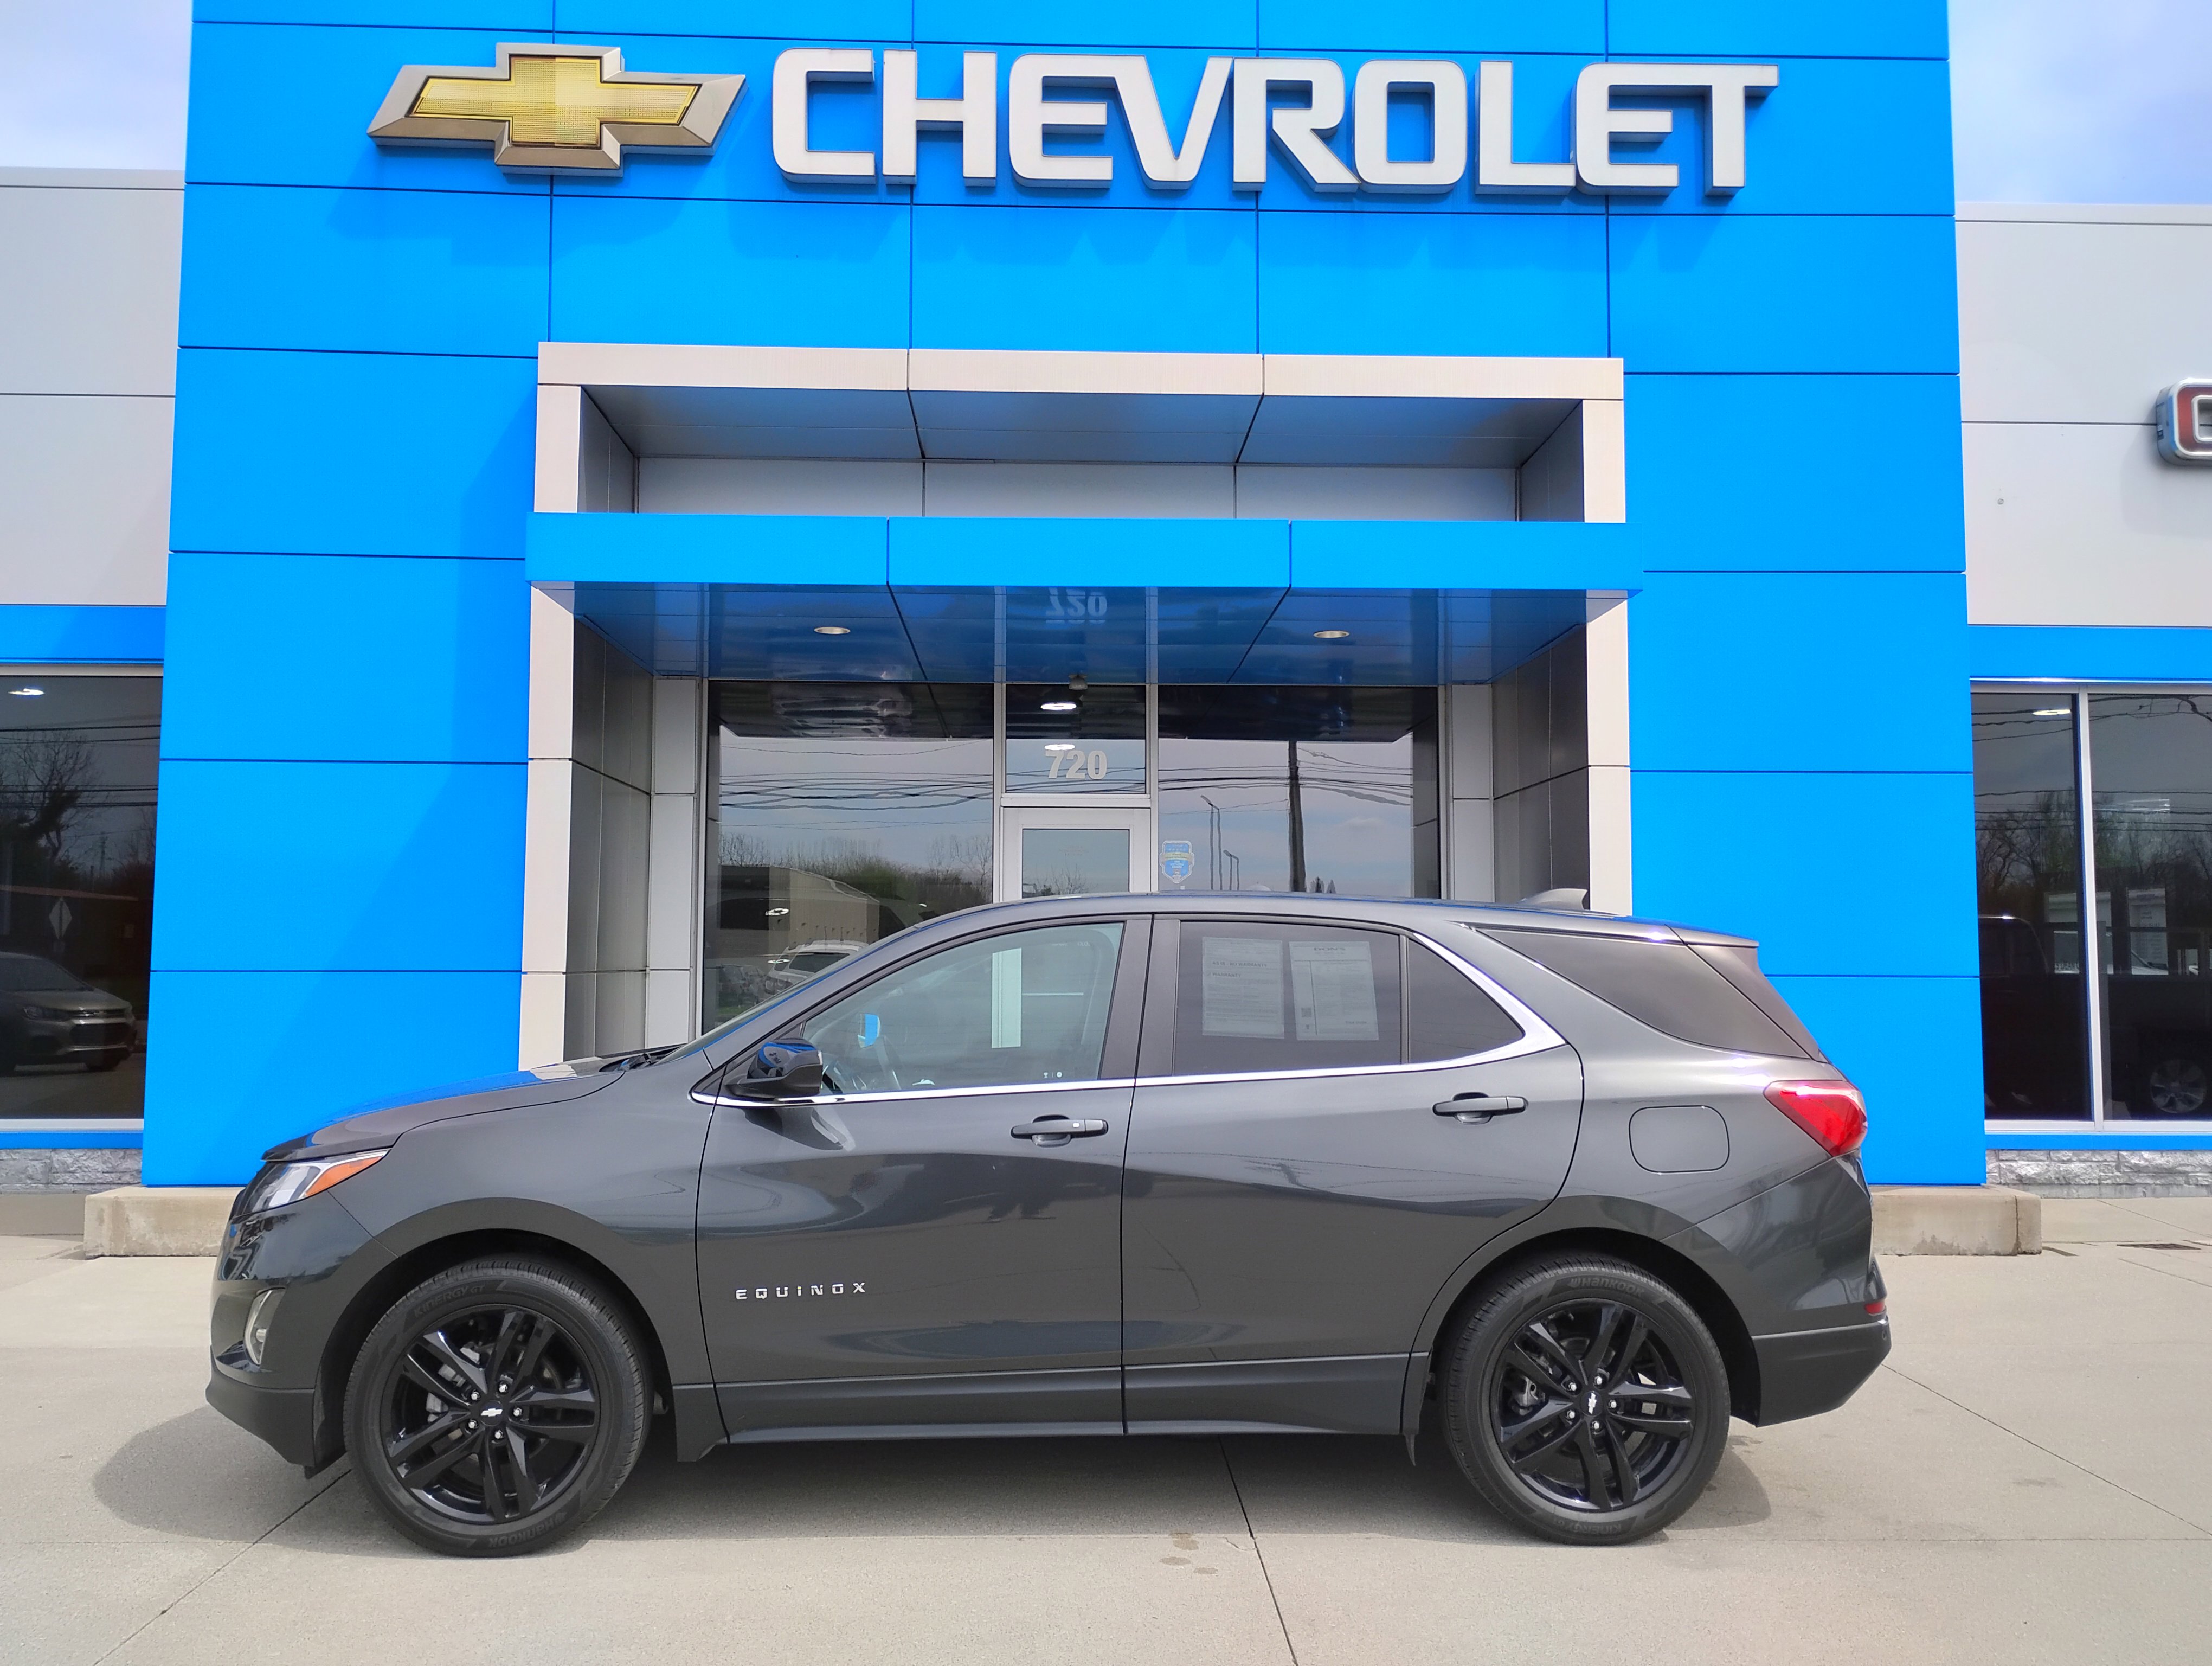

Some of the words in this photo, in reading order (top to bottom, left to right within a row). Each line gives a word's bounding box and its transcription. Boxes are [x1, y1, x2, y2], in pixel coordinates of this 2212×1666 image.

[773, 48, 1779, 195] CHEVROLET
[1045, 750, 1108, 780] 720
[735, 1282, 866, 1300] EQUINOX
